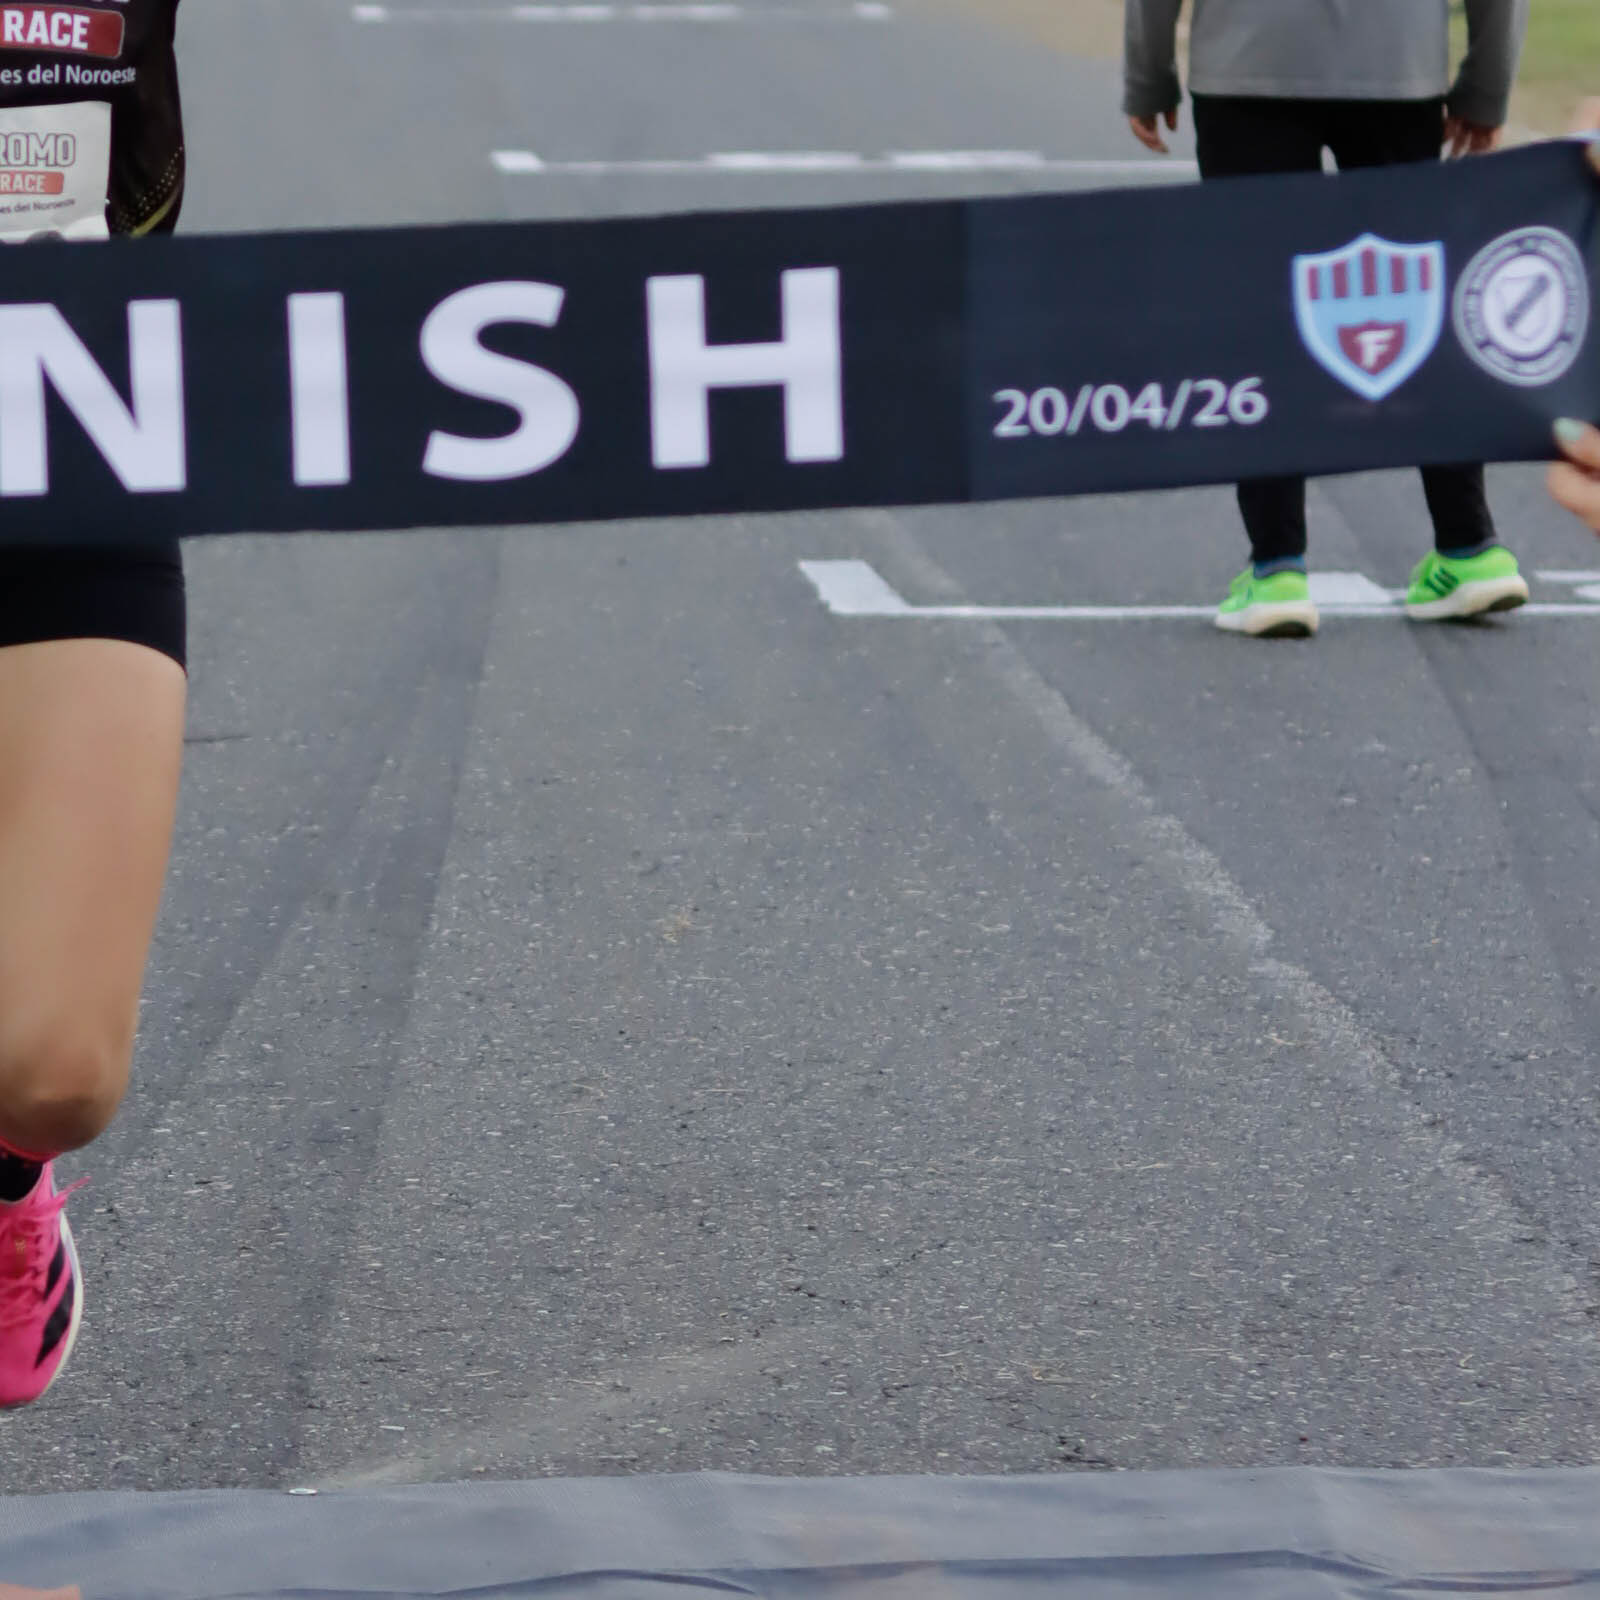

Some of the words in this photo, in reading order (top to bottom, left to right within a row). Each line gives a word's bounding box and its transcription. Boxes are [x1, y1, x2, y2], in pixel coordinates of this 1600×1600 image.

[3, 9, 90, 49] RACE
[27, 64, 60, 84] del
[66, 65, 136, 85] Noroeste
[1, 173, 46, 193] RACE
[14, 202, 30, 213] del
[992, 376, 1269, 437] 20/04/26
